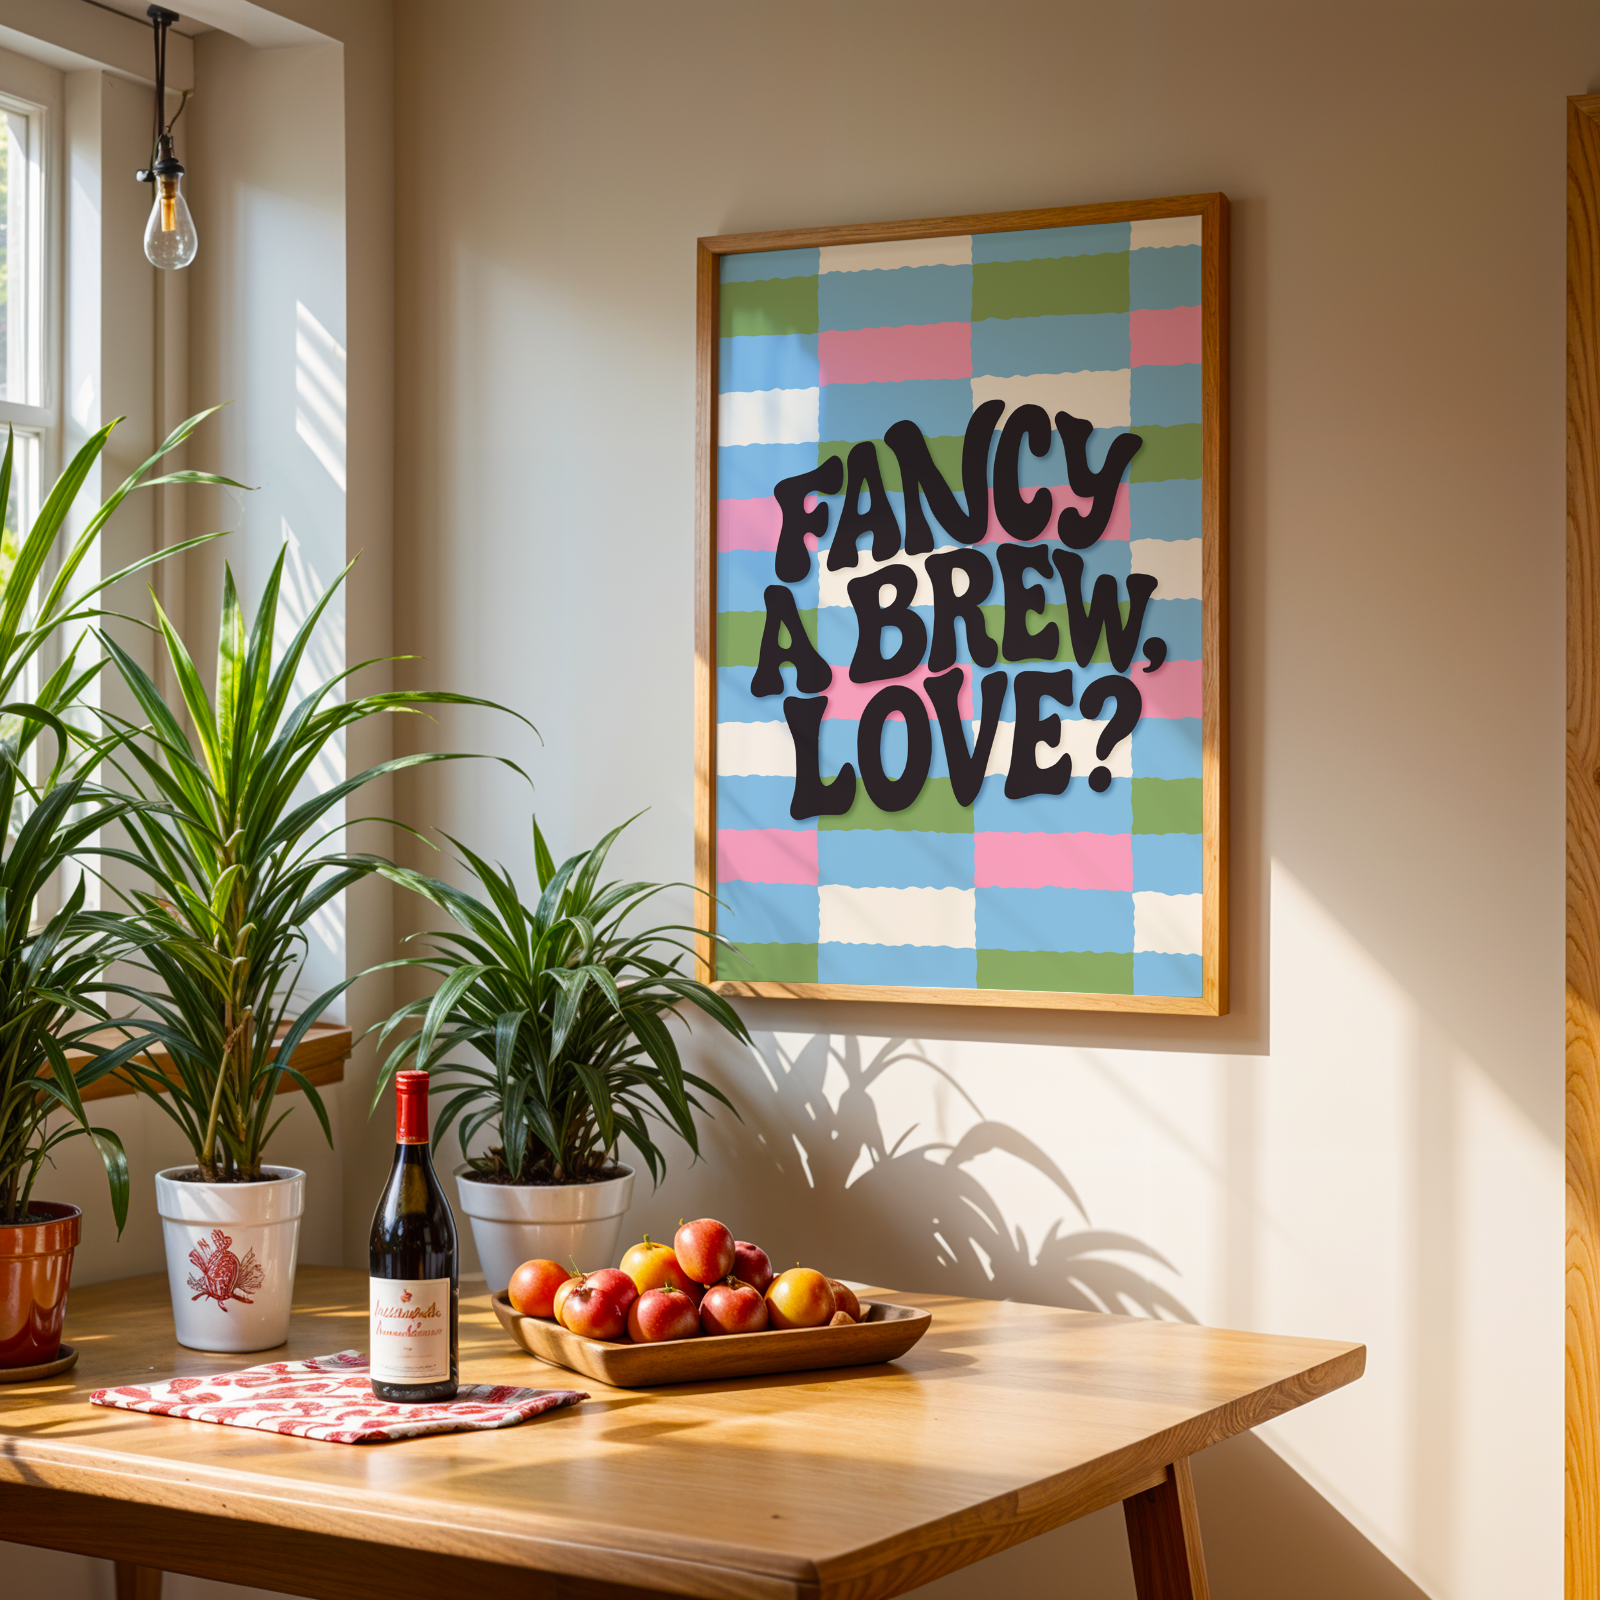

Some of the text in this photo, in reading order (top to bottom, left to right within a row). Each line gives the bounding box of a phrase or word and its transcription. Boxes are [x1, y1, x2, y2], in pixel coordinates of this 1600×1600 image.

[774, 400, 1143, 582] FANCY
[751, 544, 1167, 698] A BREW,
[784, 668, 1142, 820] LOVE?
